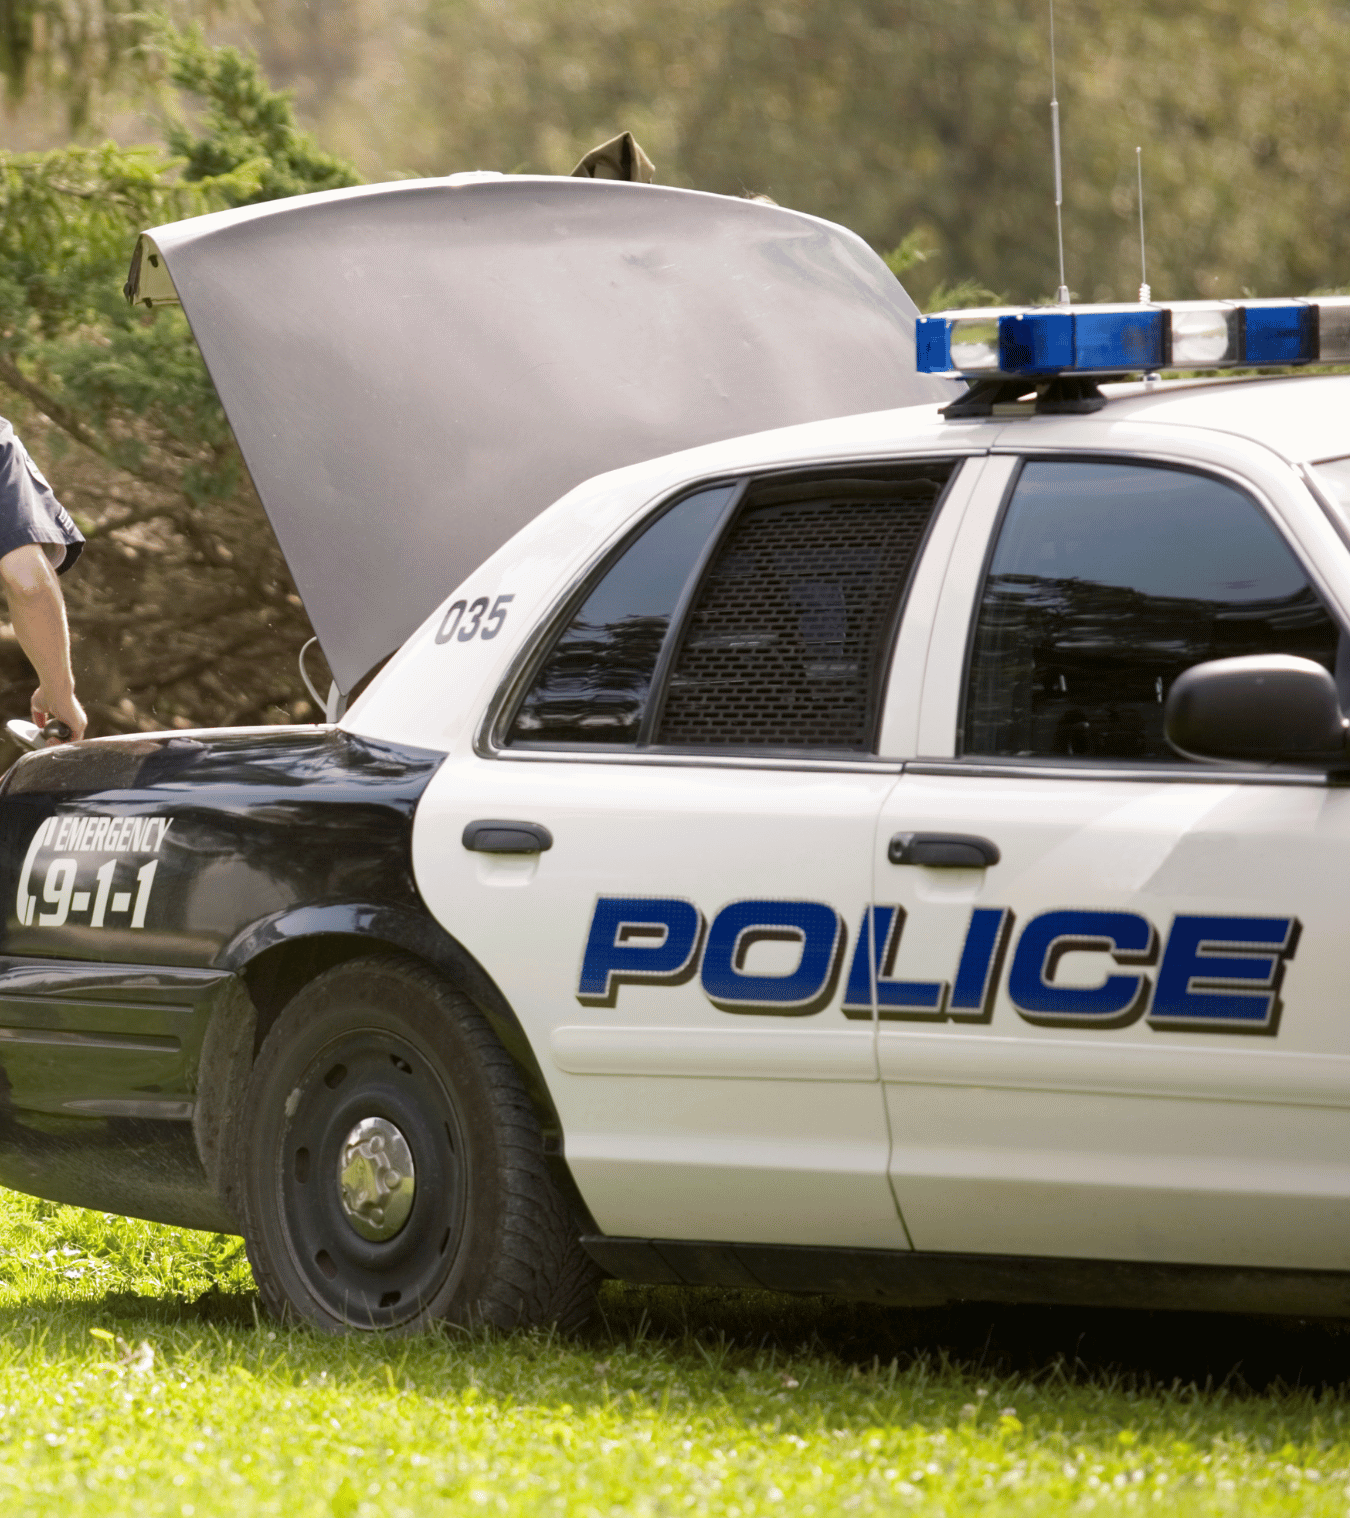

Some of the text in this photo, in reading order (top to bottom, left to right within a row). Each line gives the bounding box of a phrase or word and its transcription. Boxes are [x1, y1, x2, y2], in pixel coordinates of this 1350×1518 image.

[434, 593, 516, 645] 035
[53, 817, 174, 852] EMERGENCY
[39, 858, 158, 928] 9-1-1
[575, 893, 1304, 1037] POLICE
